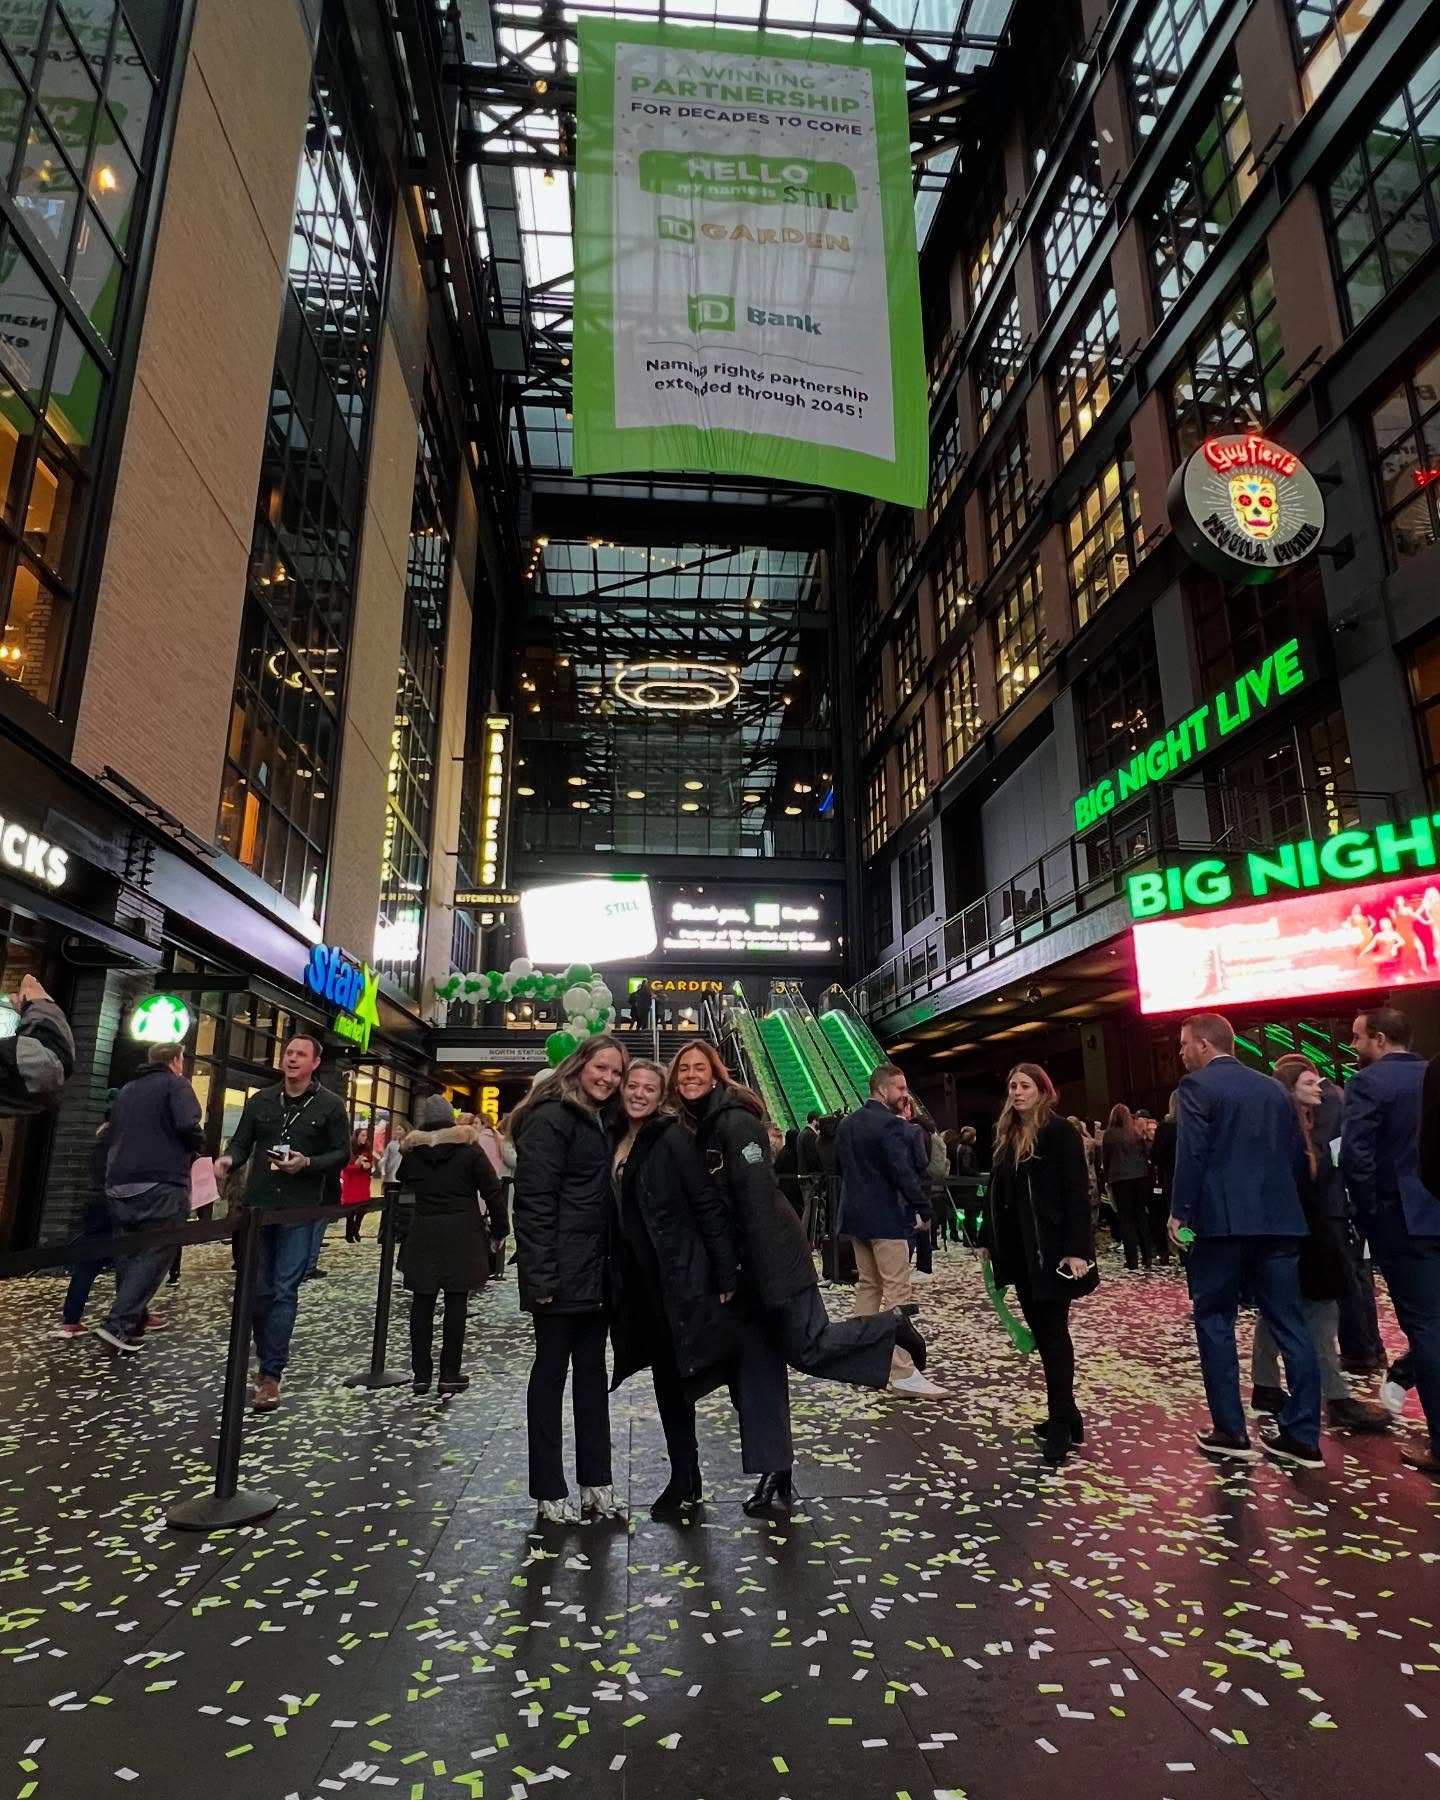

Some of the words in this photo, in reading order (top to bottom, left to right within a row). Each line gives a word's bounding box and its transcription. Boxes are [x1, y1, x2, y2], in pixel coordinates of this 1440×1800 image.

[676, 64, 692, 78] A
[701, 65, 816, 91] WINNING
[630, 76, 861, 115] PARTNERSHIP
[631, 102, 672, 117] FOR
[678, 107, 770, 125] DECADES
[775, 116, 802, 128] TO
[806, 119, 863, 136] COME
[687, 158, 810, 185] HELLO
[783, 185, 854, 213] STILL
[701, 222, 851, 252] GARDEN
[747, 306, 822, 336] Bank
[646, 359, 708, 379] Naming
[713, 362, 766, 383] rights
[770, 372, 869, 402] partnership
[654, 377, 733, 398] extended
[738, 383, 805, 408] through
[811, 399, 864, 420] 2045!
[1204, 441, 1248, 471] Guy
[1202, 513, 1268, 563] TEQUILA
[1273, 523, 1321, 563] CUCINA
[1074, 778, 1115, 832] BIG
[1118, 705, 1209, 800] NIGHT
[1215, 638, 1304, 736] LIVE
[0, 814, 69, 888] CKS
[1128, 860, 1232, 918] BIG
[1247, 813, 1440, 897] NIGH
[502, 895, 520, 904] TAP
[604, 900, 640, 916] STILL
